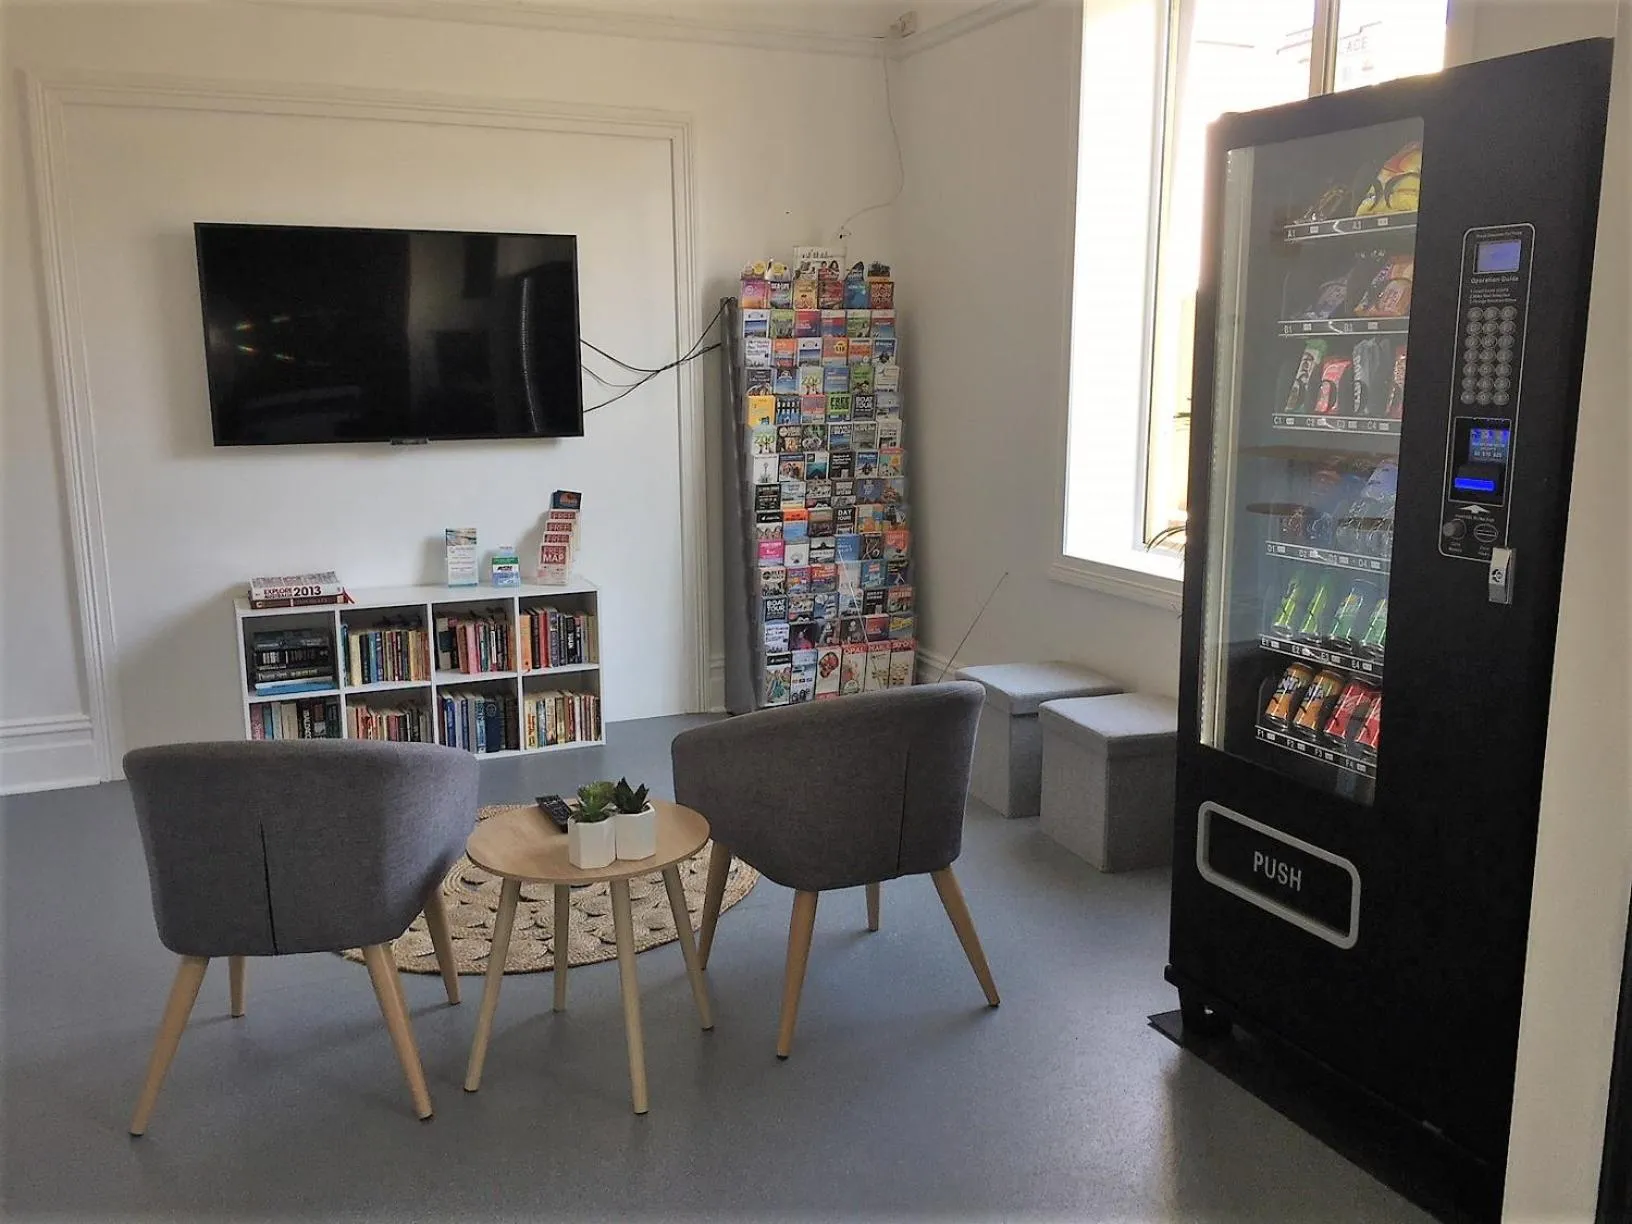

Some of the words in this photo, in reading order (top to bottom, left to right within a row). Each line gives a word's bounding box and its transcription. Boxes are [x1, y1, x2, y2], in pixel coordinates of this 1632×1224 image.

[543, 554, 564, 562] MAP
[293, 586, 322, 597] 2013
[1291, 645, 1300, 654] E2
[1351, 660, 1360, 669] E4
[1257, 729, 1264, 738] F1
[1286, 739, 1294, 748] F2
[1314, 748, 1323, 757] F3
[1253, 851, 1302, 892] PUSH
